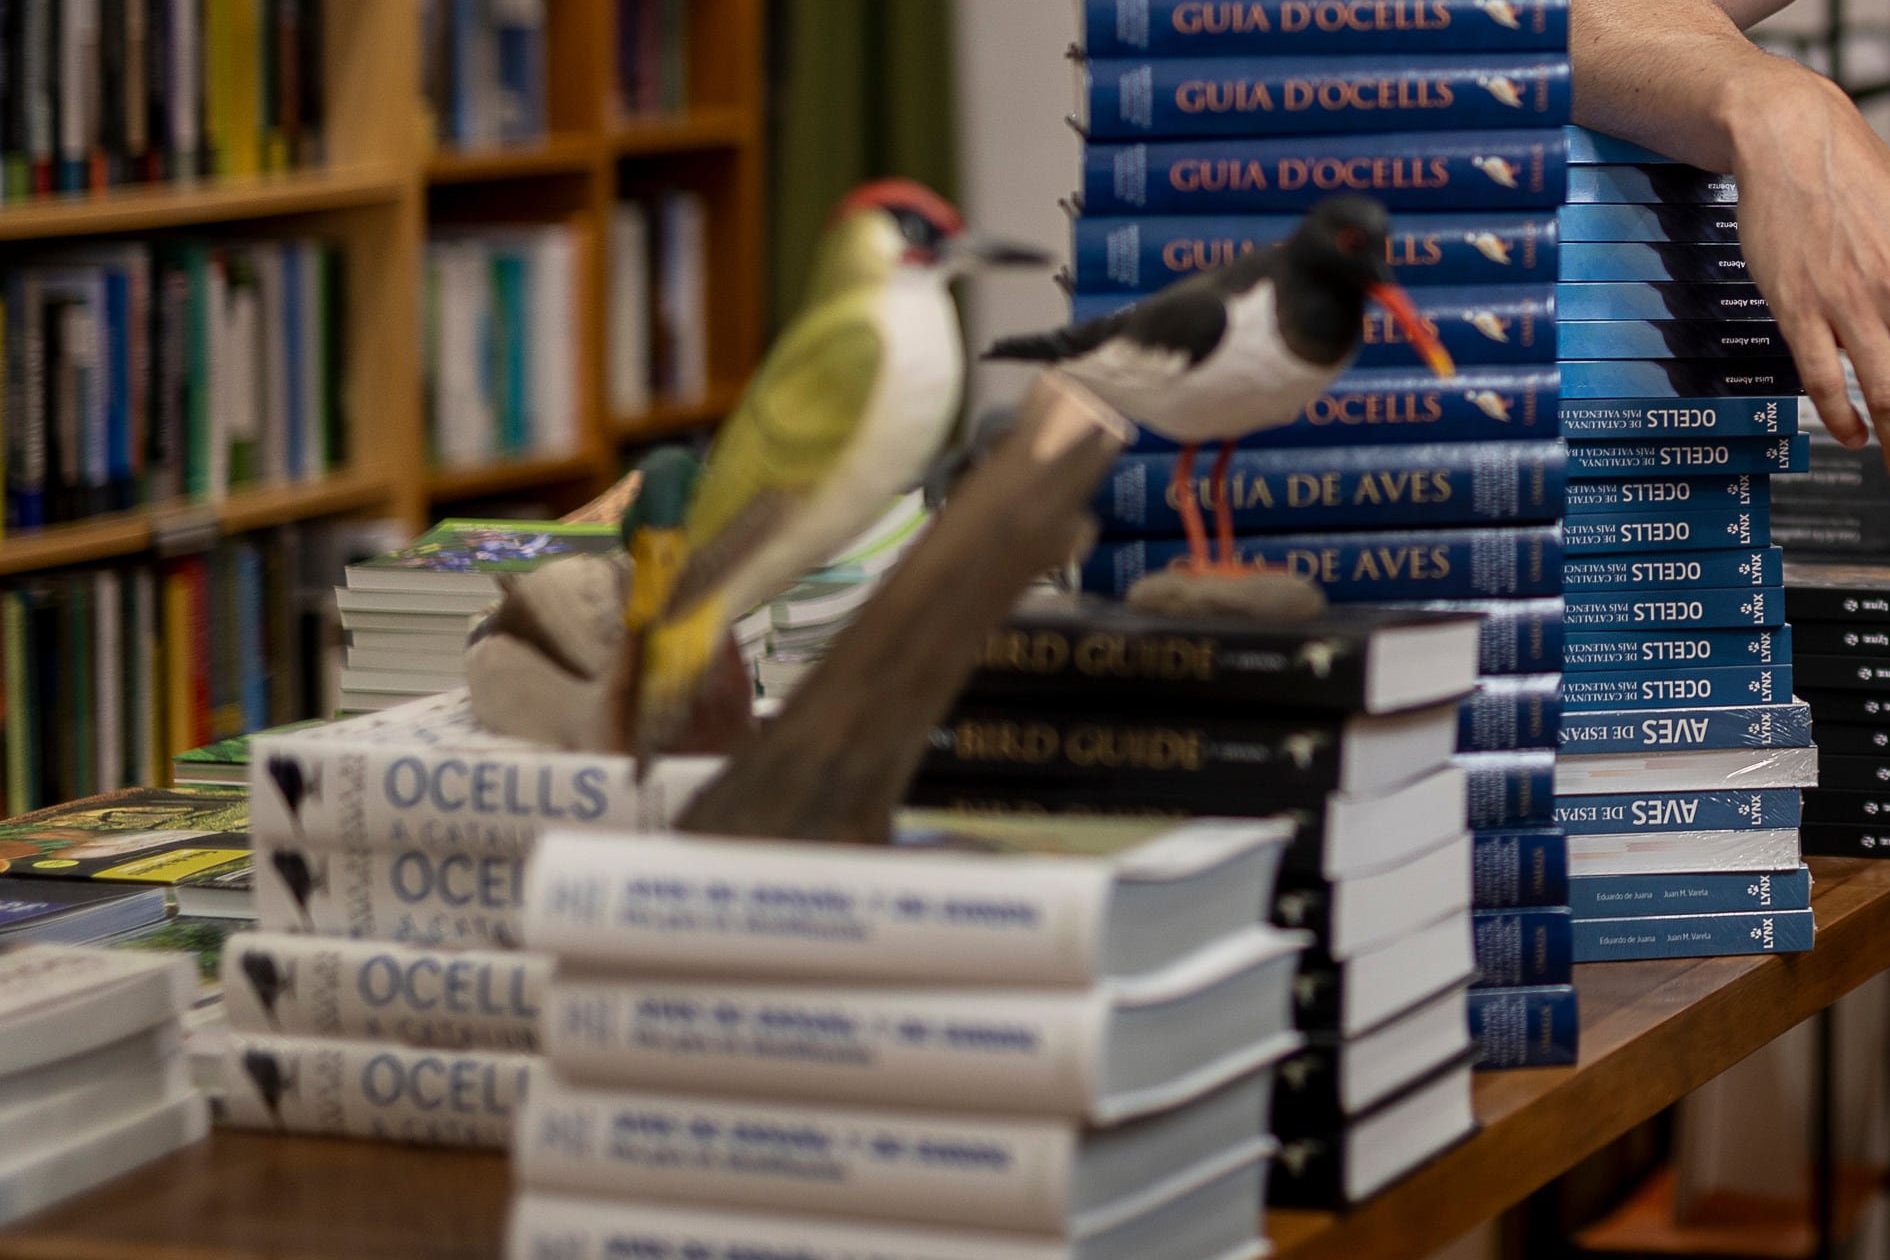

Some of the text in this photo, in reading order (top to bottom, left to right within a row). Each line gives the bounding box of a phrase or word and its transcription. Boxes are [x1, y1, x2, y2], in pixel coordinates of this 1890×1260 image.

[1172, 1, 1270, 34] GUIA
[1175, 80, 1274, 113] GUIA
[1284, 77, 1454, 111] D'OCELLS
[1169, 158, 1267, 192] GUIA
[1277, 155, 1449, 190] D'OCELLS
[1708, 183, 1735, 191] Abenza
[1716, 222, 1738, 230] benza
[1719, 260, 1746, 268] Abenza
[1721, 299, 1768, 307] uisa Abenza
[1751, 337, 1769, 345] Luisa
[1755, 376, 1773, 384] Luisa
[1305, 394, 1443, 425] OCELLS
[1572, 410, 1619, 420] VALENCIÀ
[1623, 410, 1641, 418] PAÍS
[1647, 409, 1716, 427] OCELLS
[1767, 402, 1777, 432] LYNX
[1627, 420, 1641, 428] DE
[1585, 448, 1632, 457] VALENCIÀ
[1636, 448, 1654, 456] PAÍS
[1661, 446, 1728, 464] OCELLS
[1779, 439, 1789, 468] LYNX
[1287, 471, 1341, 508] DE
[1354, 470, 1452, 505] AVES
[1564, 485, 1616, 494] PAÍS VALEN
[1622, 483, 1690, 501] OCELLS
[1740, 475, 1750, 504] LYNX
[1567, 495, 1616, 504] DE CATALU
[1563, 525, 1615, 534] PAÍS VALEN
[1622, 522, 1689, 542] OCELLS
[1740, 513, 1750, 544] LYNX
[1564, 535, 1615, 544] DE CATALU
[1287, 546, 1341, 582] DE
[1354, 546, 1450, 581] AVES
[1563, 564, 1626, 573] PAÍS VALENCI
[1632, 562, 1701, 581] OCELLS
[1752, 554, 1762, 584] LYNX
[1564, 574, 1626, 584] DE CATALUN
[1565, 603, 1628, 613] PAÍS VALENCI
[1634, 601, 1702, 621] OCELLS
[1754, 593, 1764, 624] LYNX
[1616, 614, 1628, 622] DE
[1569, 643, 1615, 653] VALENCIÀ
[1618, 642, 1637, 651] PAÍS
[1643, 640, 1711, 660] OCELLS
[1761, 632, 1771, 662] LYNX
[1624, 653, 1637, 661] DE
[1569, 683, 1615, 693] VALENCIÀ
[1618, 682, 1637, 691] PAÍS
[1643, 679, 1711, 699] OCELLS
[1761, 671, 1772, 701] LYNX
[1624, 692, 1637, 700] DE
[1557, 726, 1634, 744] DE ESPAÑ
[1642, 718, 1709, 744] AVES
[1761, 713, 1771, 744] LYNX
[383, 755, 609, 821] OCELLS
[1602, 806, 1623, 819] DE
[1632, 799, 1698, 825] AVES
[1752, 794, 1761, 825] LYNX
[1634, 891, 1652, 899] Juana
[1664, 890, 1681, 898] Juan
[1760, 875, 1771, 906] LYNX
[1600, 936, 1626, 945] Eduardo
[1627, 935, 1635, 943] de
[1637, 935, 1655, 943] Juana
[1667, 934, 1684, 942] Juan
[1764, 919, 1773, 949] LYNX
